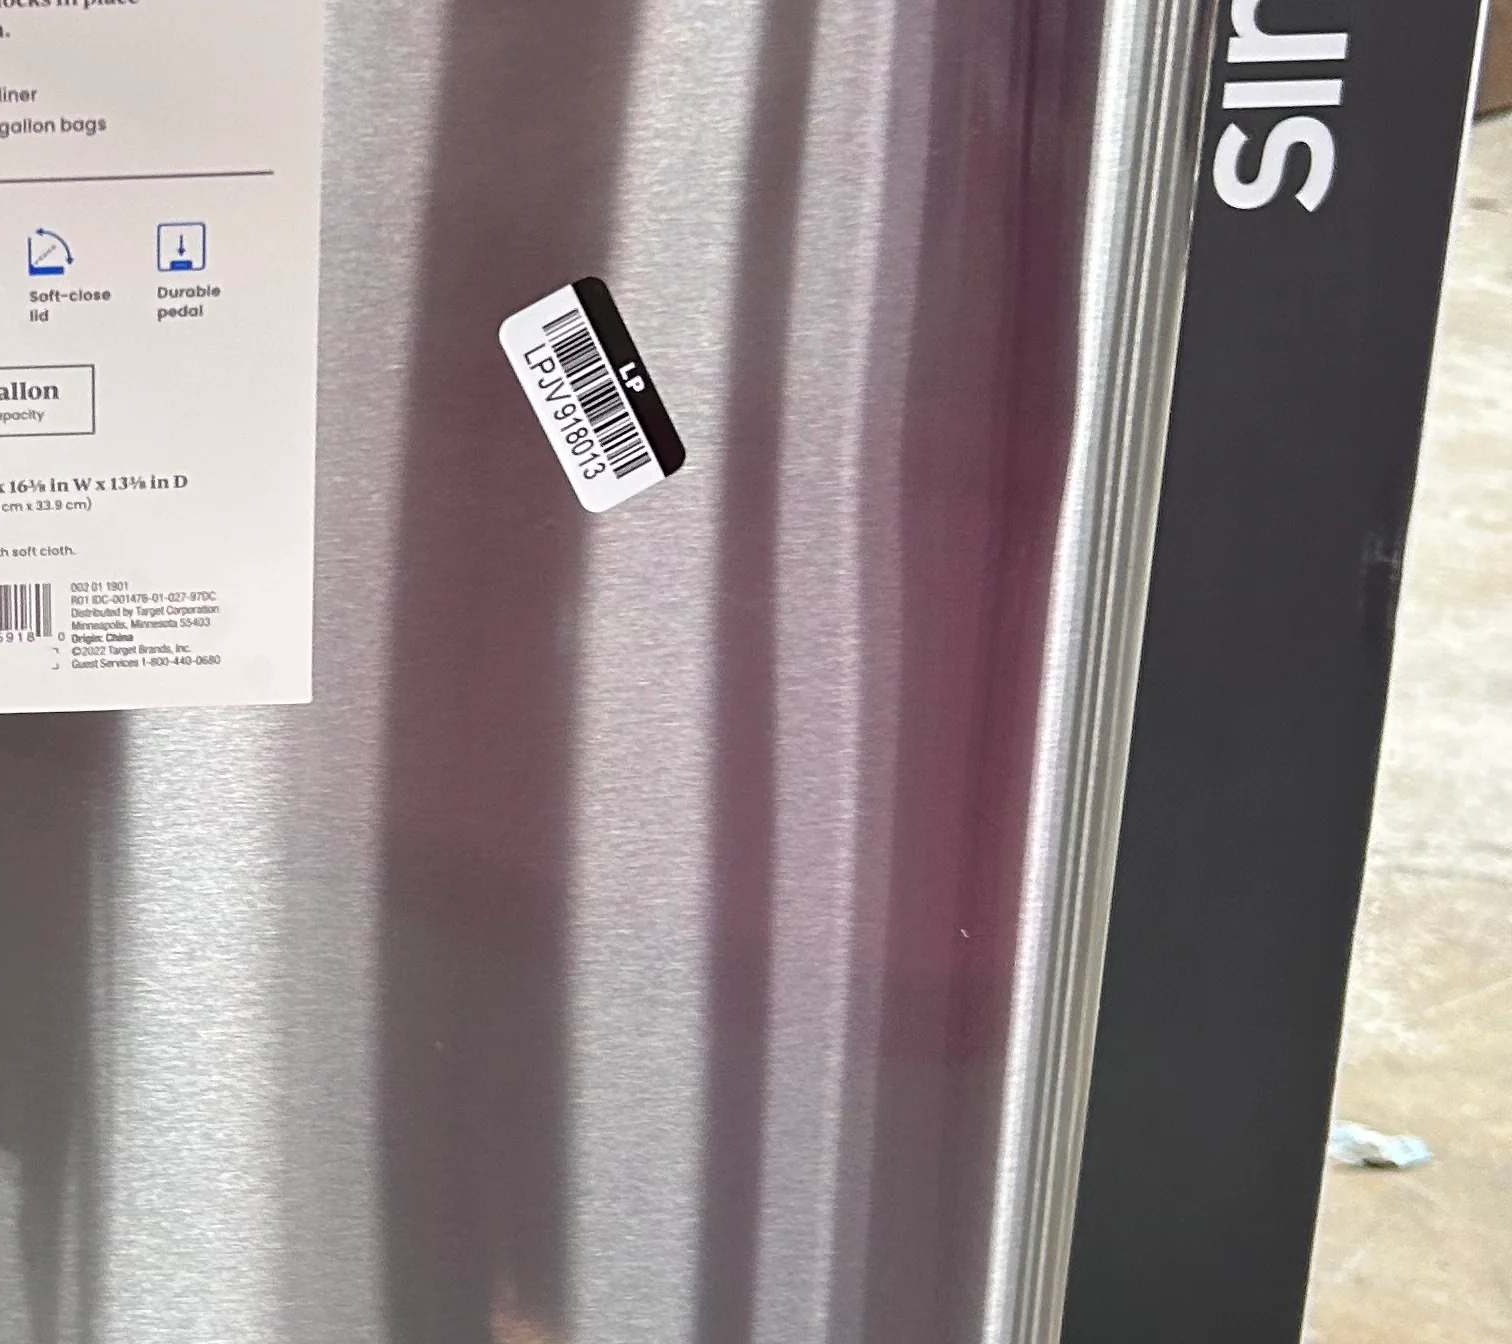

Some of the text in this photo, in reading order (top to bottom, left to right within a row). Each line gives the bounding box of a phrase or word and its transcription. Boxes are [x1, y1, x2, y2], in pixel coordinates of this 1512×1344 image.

[60, 116, 108, 136] bags
[29, 288, 112, 304] Soft-close
[157, 284, 221, 300] Durable
[29, 309, 49, 323] lid
[157, 304, 204, 322] pedal
[618, 362, 645, 392] LP
[523, 343, 606, 480] LPJV918013
[50, 477, 69, 493] in
[72, 476, 92, 492] W
[95, 479, 106, 491] x
[150, 473, 170, 490] in
[173, 474, 189, 490] D
[1, 502, 24, 512] cm
[12, 545, 37, 557] soft
